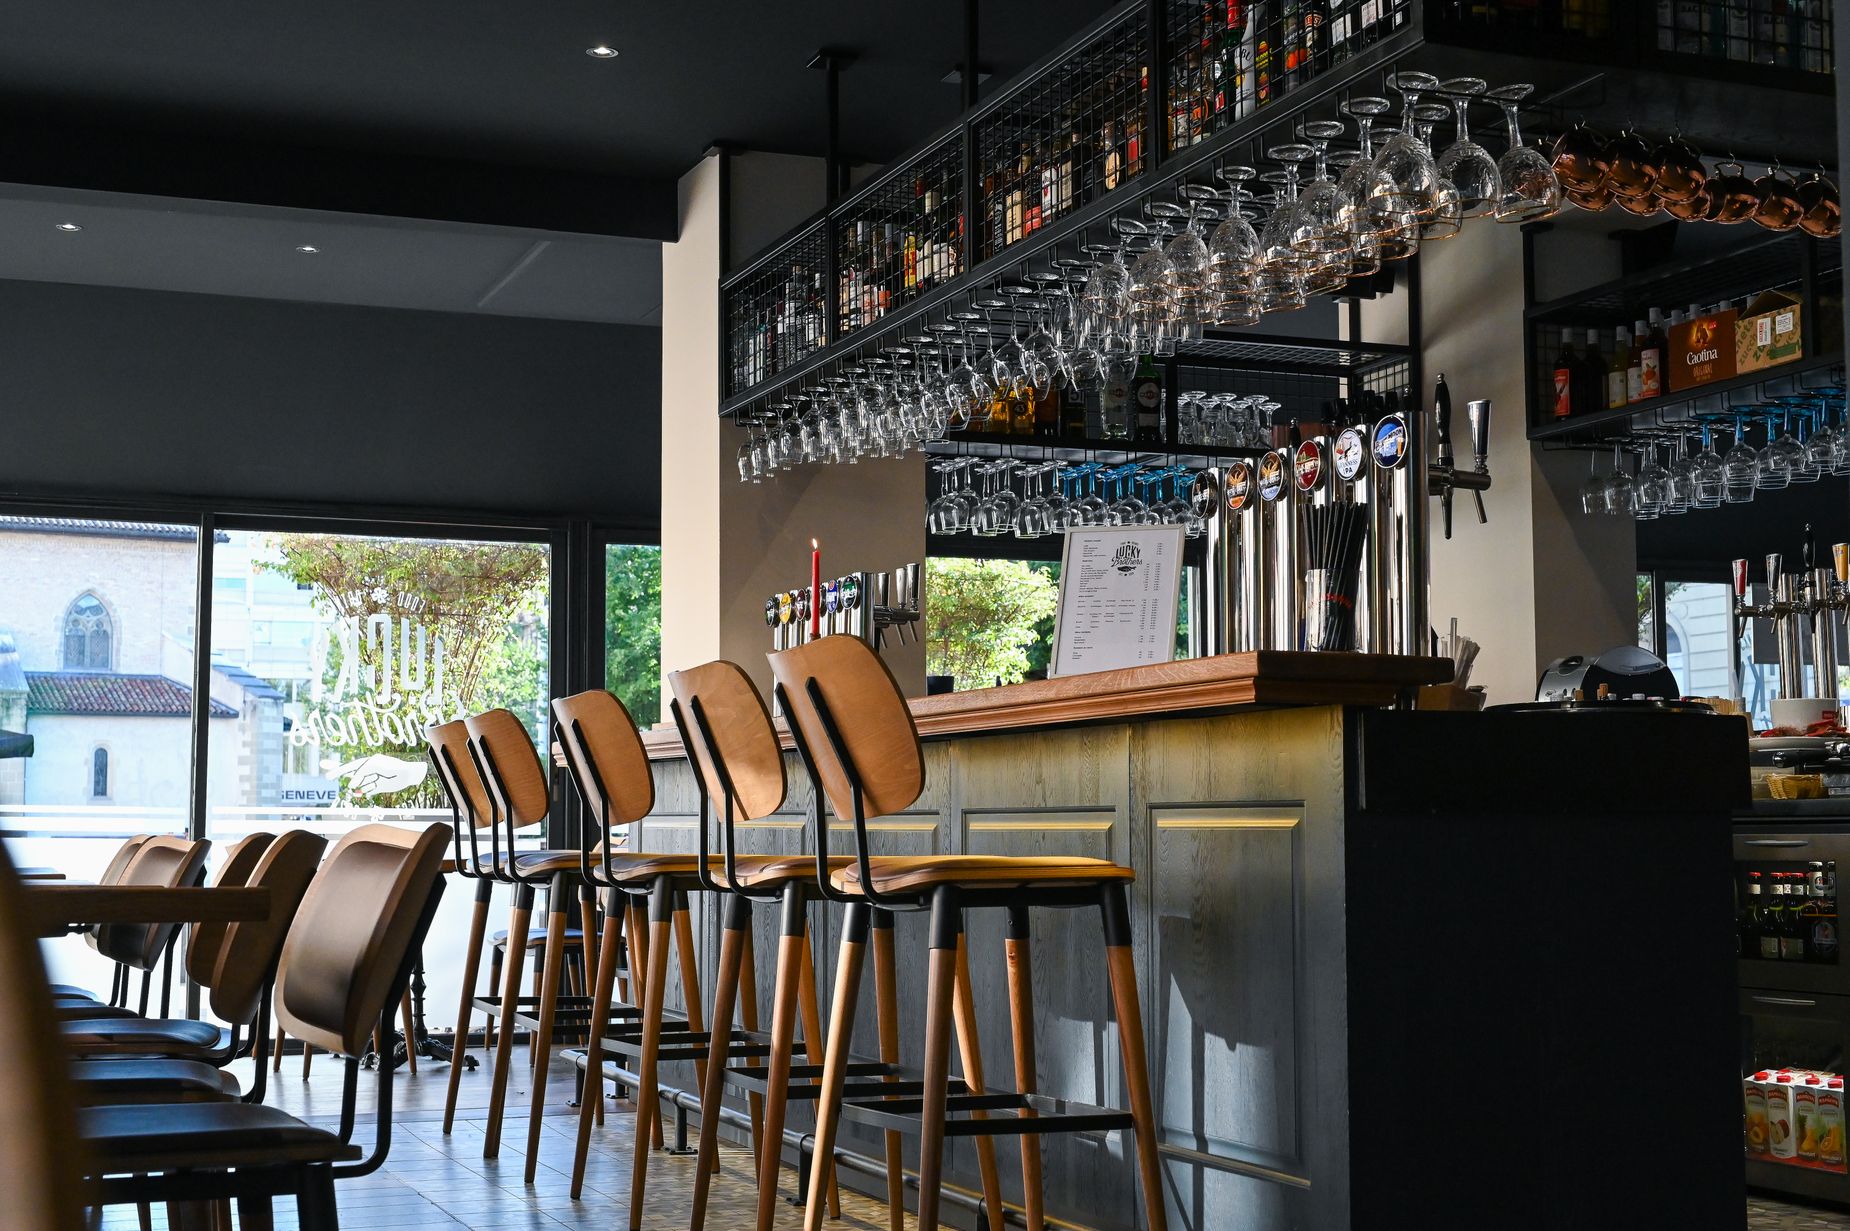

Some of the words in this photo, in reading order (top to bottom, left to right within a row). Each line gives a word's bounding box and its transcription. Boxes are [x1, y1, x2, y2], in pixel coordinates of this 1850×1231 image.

[1686, 348, 1719, 366] Caotina
[1343, 467, 1353, 475] IPA
[1115, 544, 1141, 559] LUCKY
[1111, 556, 1143, 568] Brothers
